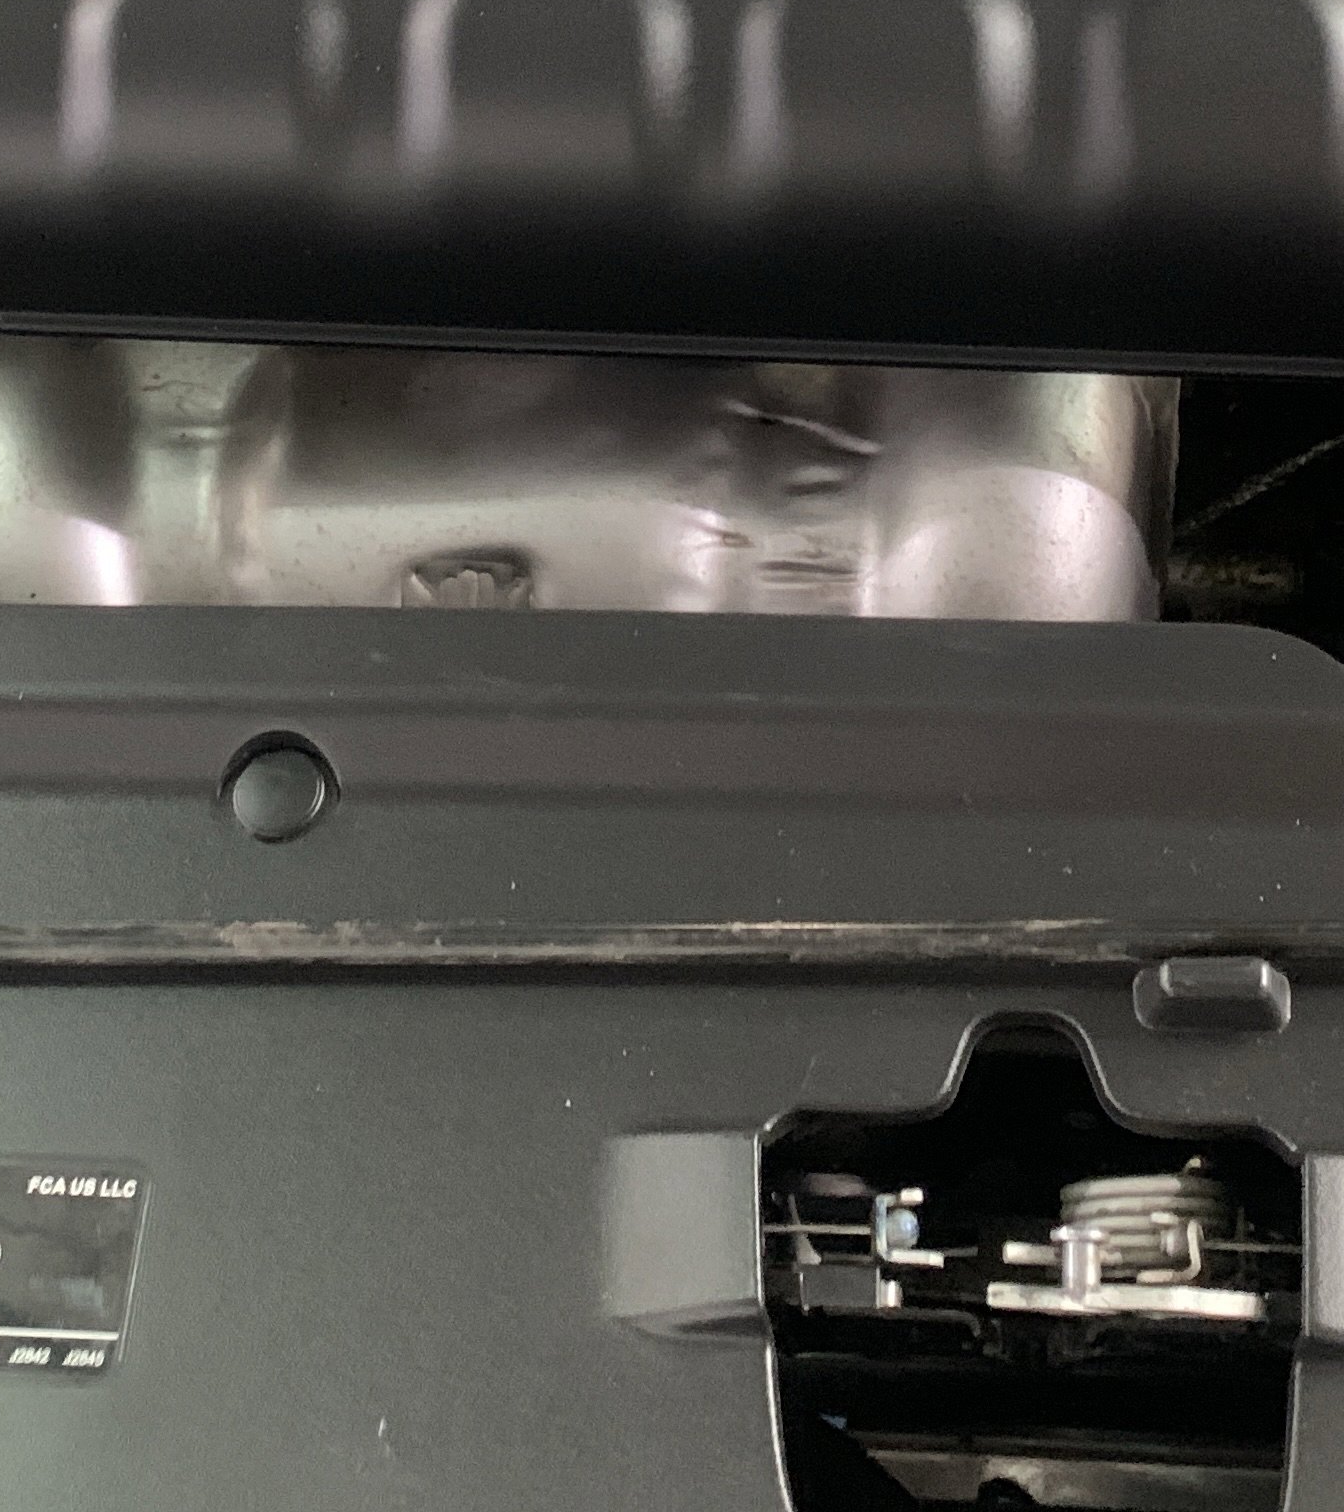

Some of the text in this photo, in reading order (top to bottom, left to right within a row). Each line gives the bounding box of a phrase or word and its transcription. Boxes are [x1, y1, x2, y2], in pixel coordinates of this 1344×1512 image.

[26, 1174, 139, 1200] FCA US LLC
